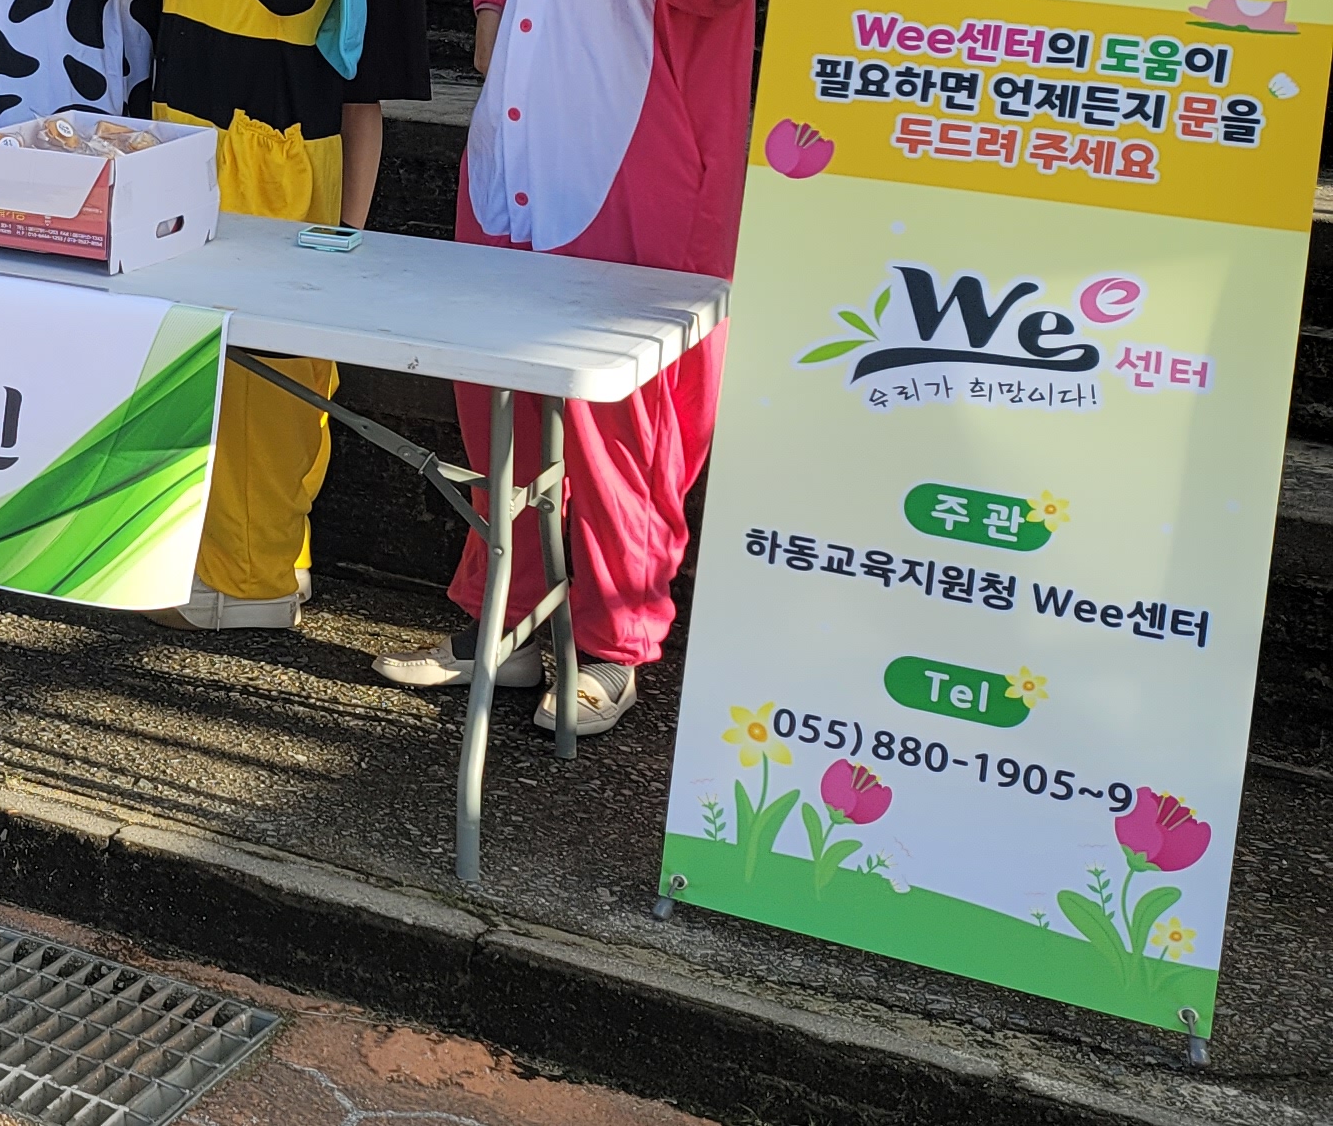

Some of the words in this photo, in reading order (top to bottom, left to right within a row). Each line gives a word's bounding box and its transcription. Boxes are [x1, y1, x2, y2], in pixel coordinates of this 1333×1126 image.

[855, 11, 1089, 70] Wee센터의
[1099, 36, 1229, 85] 도움이
[814, 57, 979, 110] 필요하면
[993, 74, 1167, 130] 언제든지
[1178, 95, 1265, 145] 문을
[895, 117, 1019, 166] 두드려
[1029, 132, 1159, 182] 주세요
[868, 265, 1142, 376] Wee
[969, 376, 1099, 407] 희망이다!
[1115, 347, 1208, 388] 센터
[745, 528, 1017, 612] 하동교육지원청
[1034, 583, 1209, 647] Wee센터
[924, 671, 989, 713] Tel
